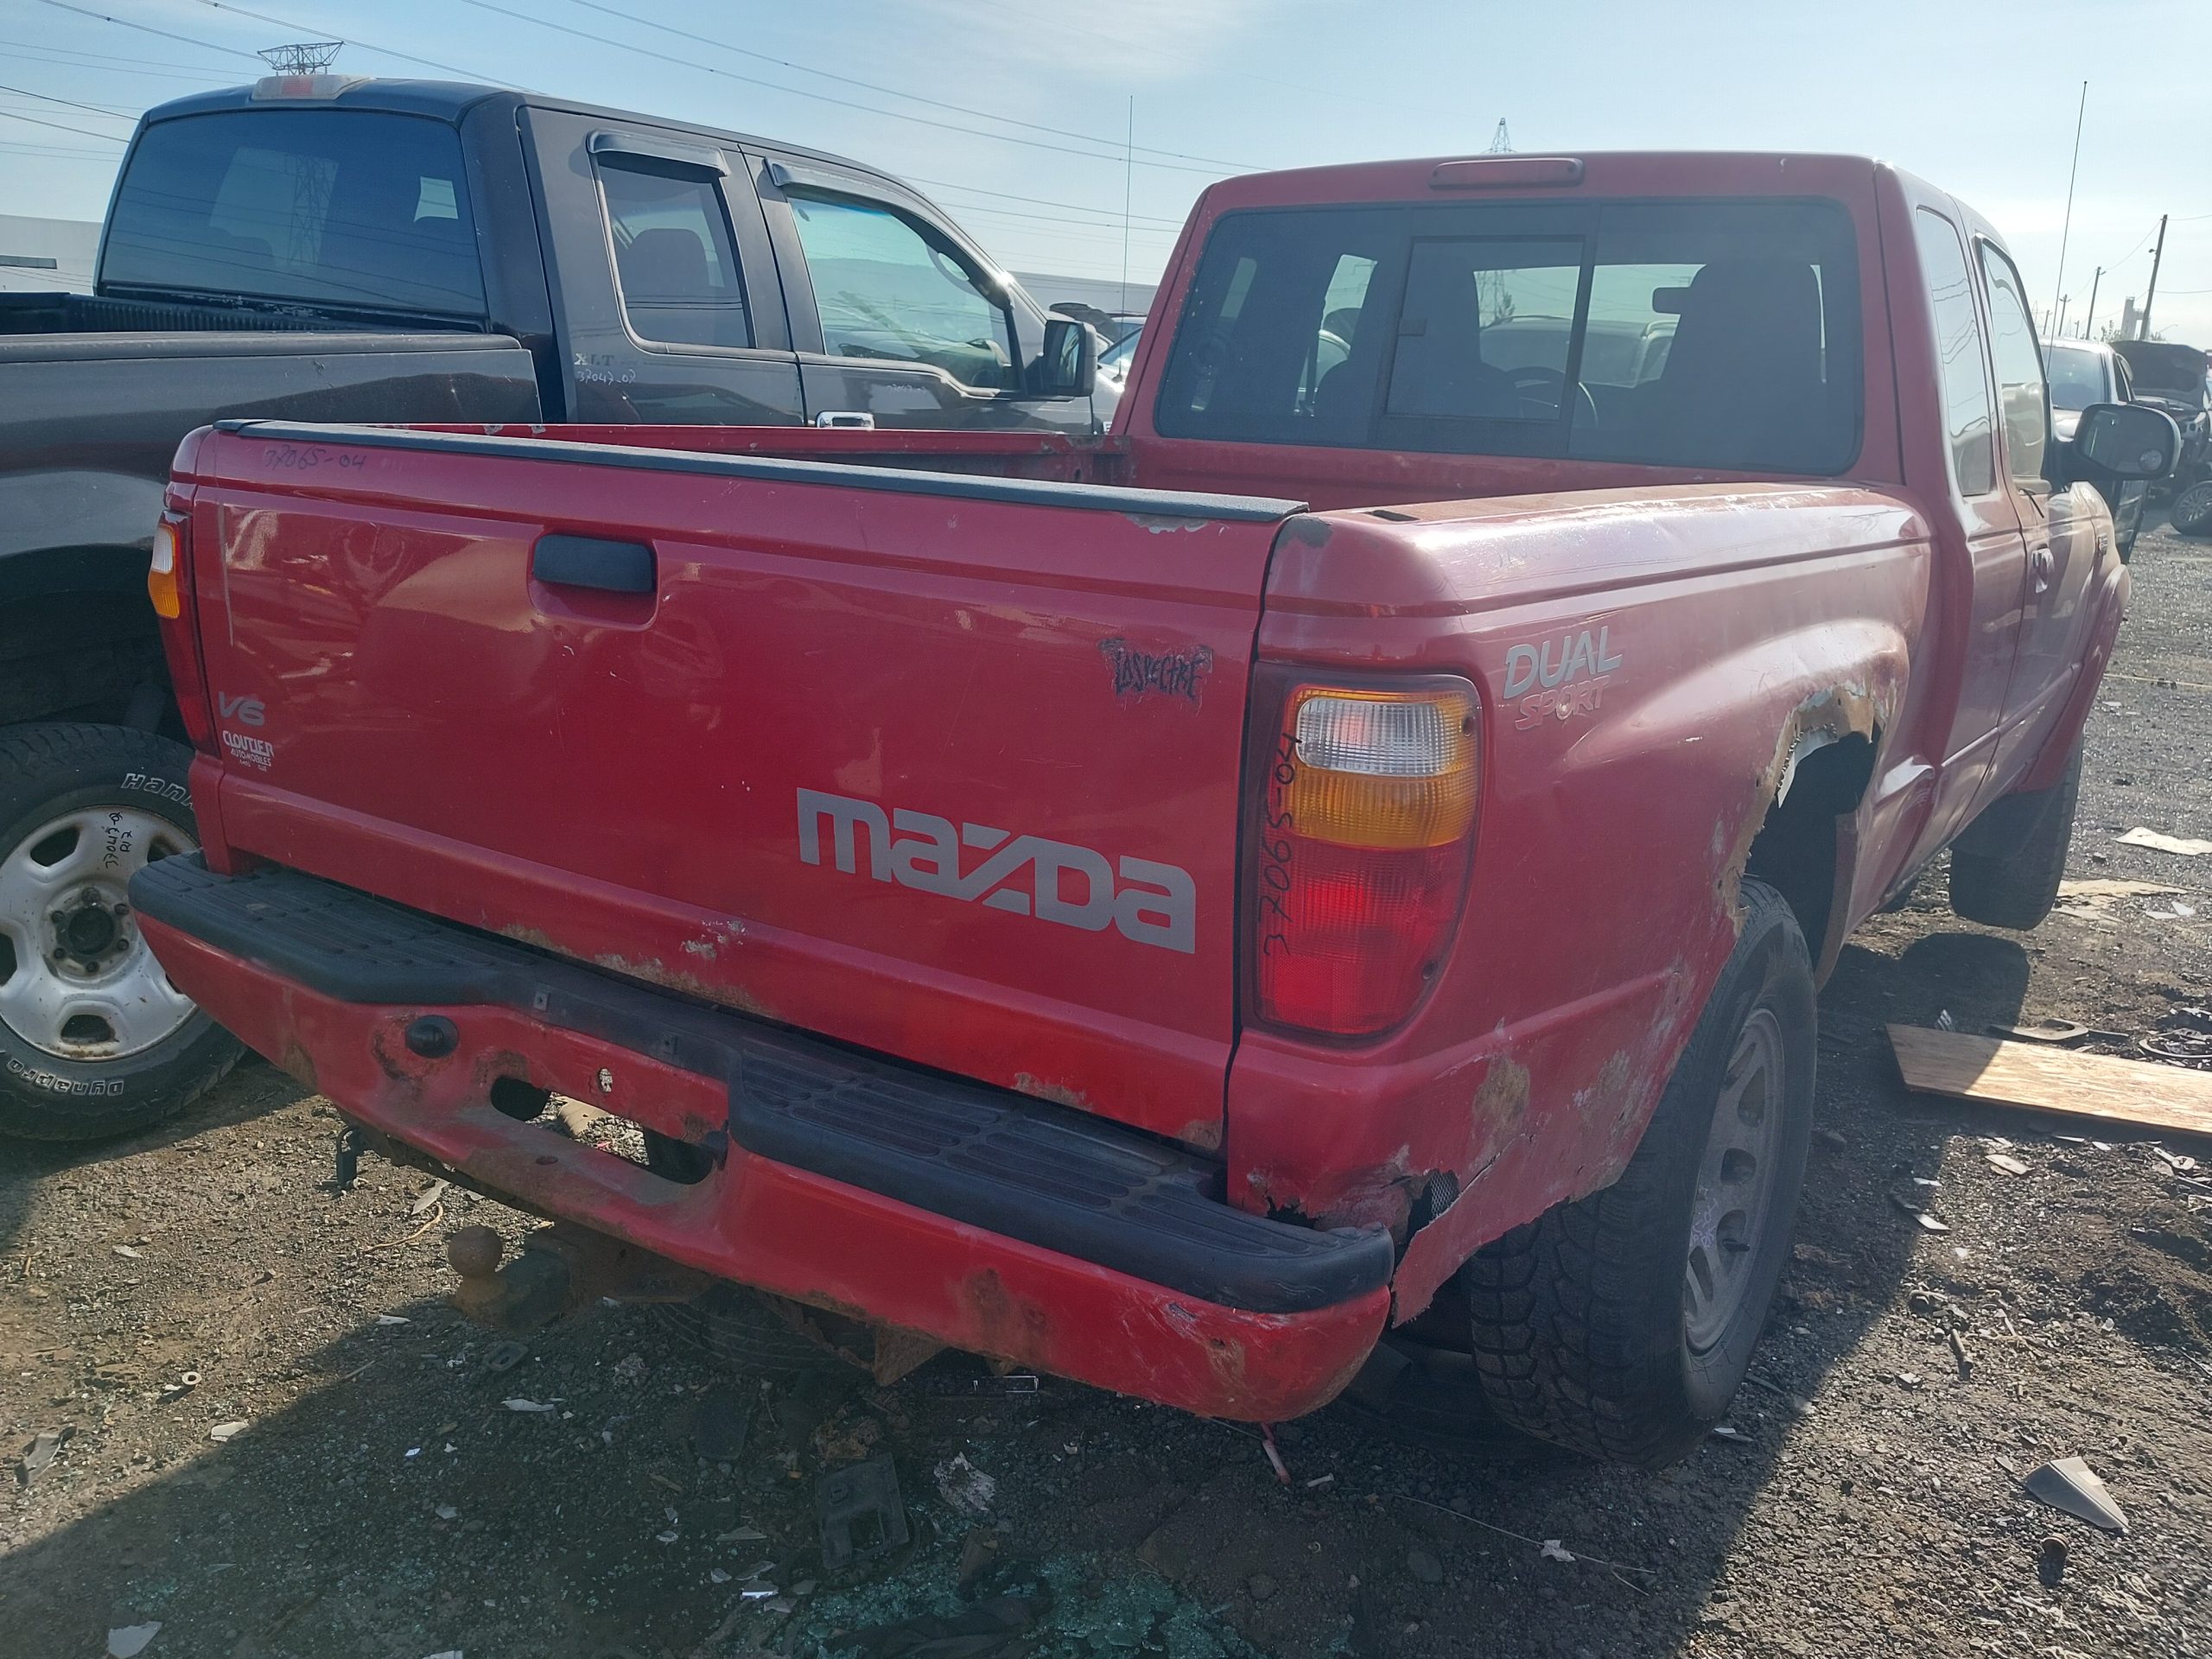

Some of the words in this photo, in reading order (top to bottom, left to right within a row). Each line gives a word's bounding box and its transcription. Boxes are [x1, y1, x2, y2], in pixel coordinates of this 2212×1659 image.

[575, 353, 614, 366] XLT
[1503, 626, 1623, 699] DUAL
[219, 691, 266, 726] V6
[1515, 675, 1610, 731] SPORT
[222, 730, 275, 758] CLOUTIER
[1259, 732, 1302, 957] 37065-04
[5, 1058, 124, 1096] Dynapro
